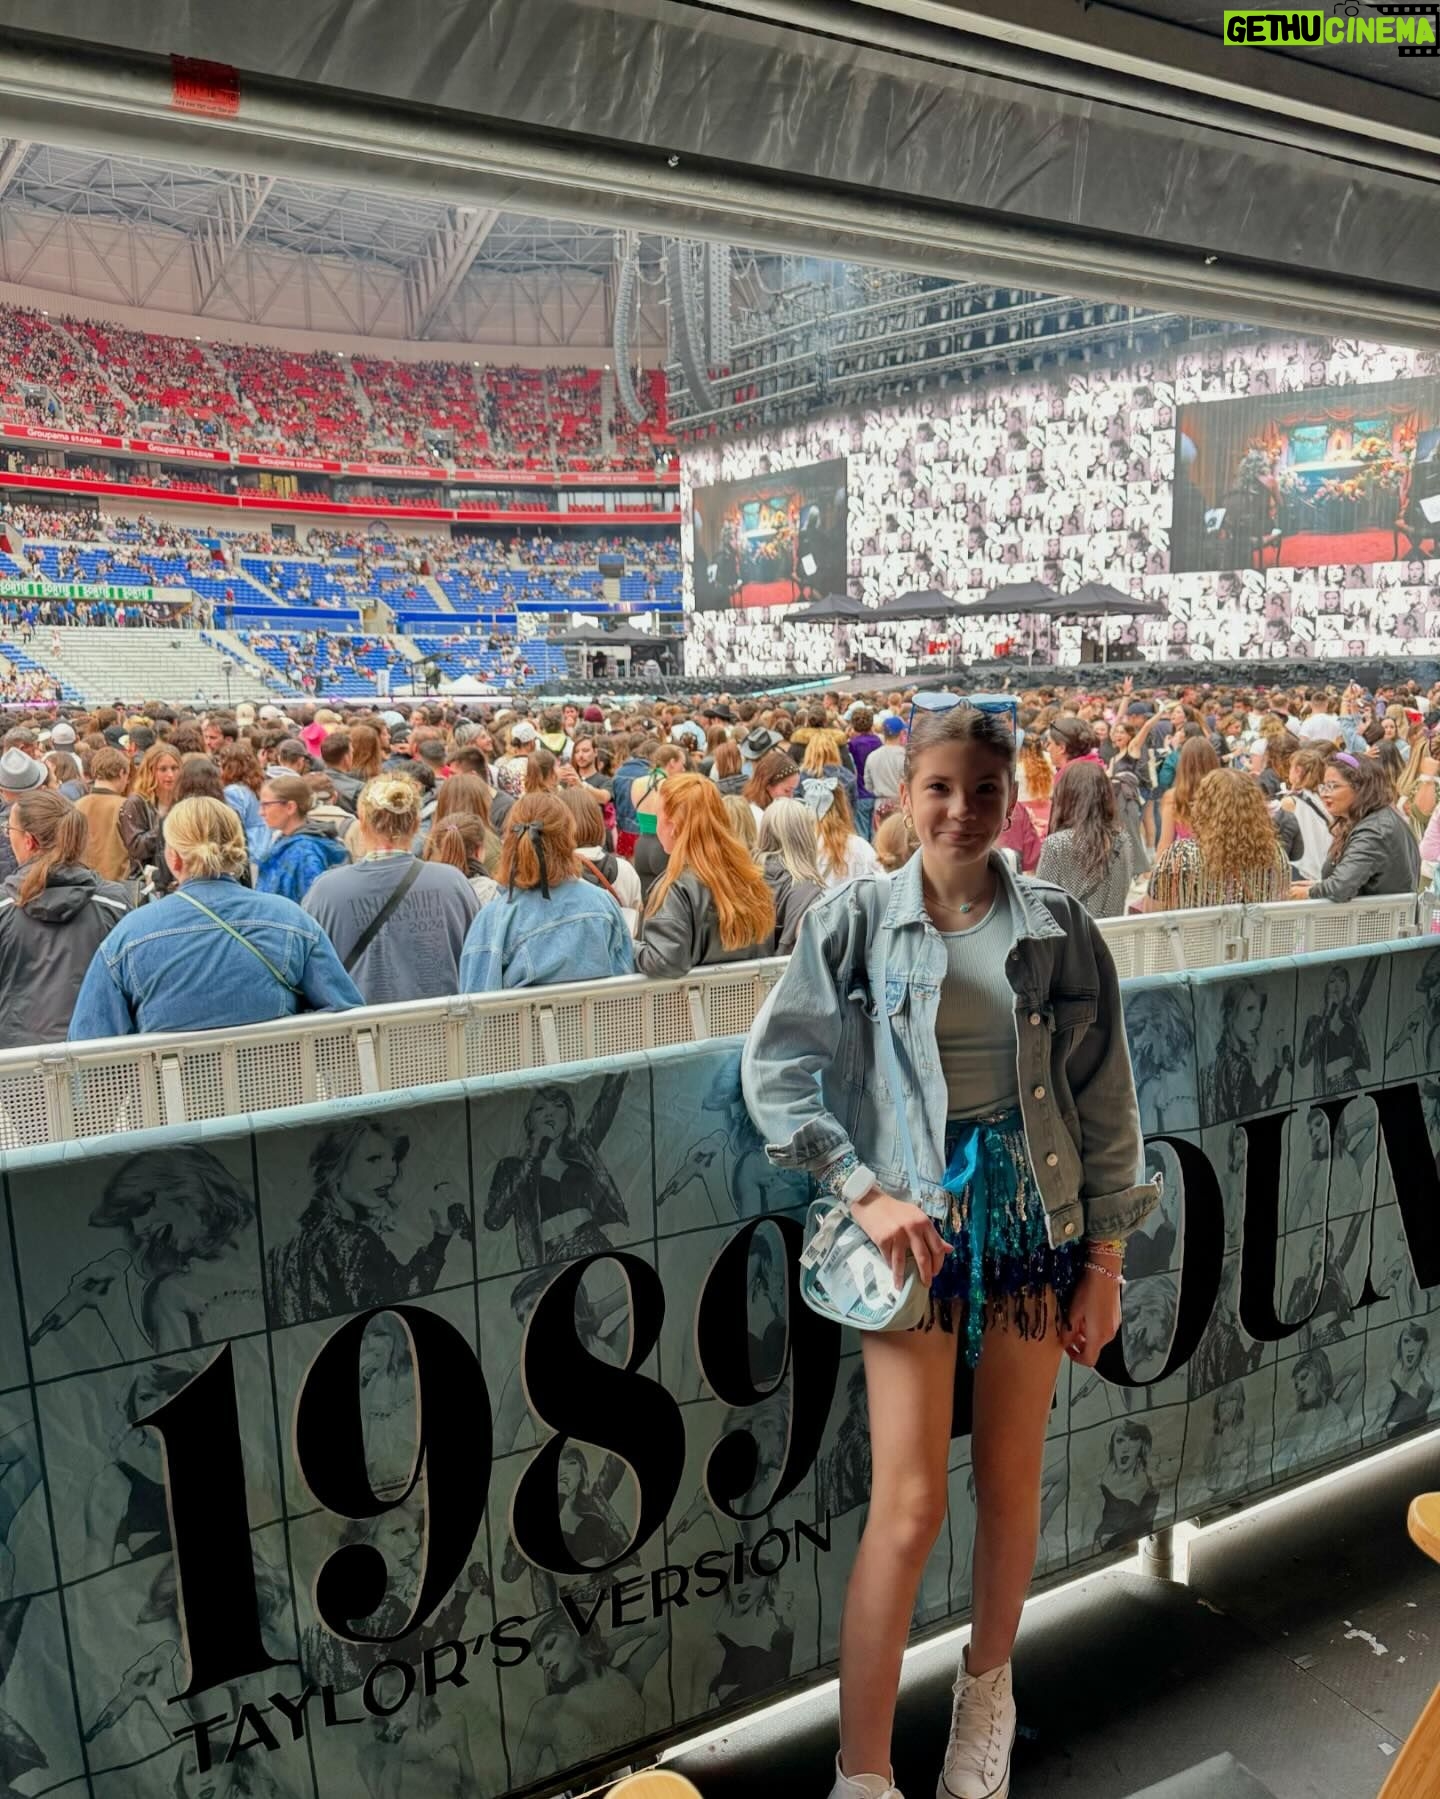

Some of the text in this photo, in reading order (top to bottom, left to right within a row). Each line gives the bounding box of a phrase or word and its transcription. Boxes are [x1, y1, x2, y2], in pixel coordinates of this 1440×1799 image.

[27, 428, 103, 445] Groupama STADIUM
[148, 443, 215, 459] Groupama STADIUM
[408, 919, 445, 933] 2024
[132, 1215, 842, 1706] 1989
[173, 1510, 832, 1774] TAYLOR'S VERSION
